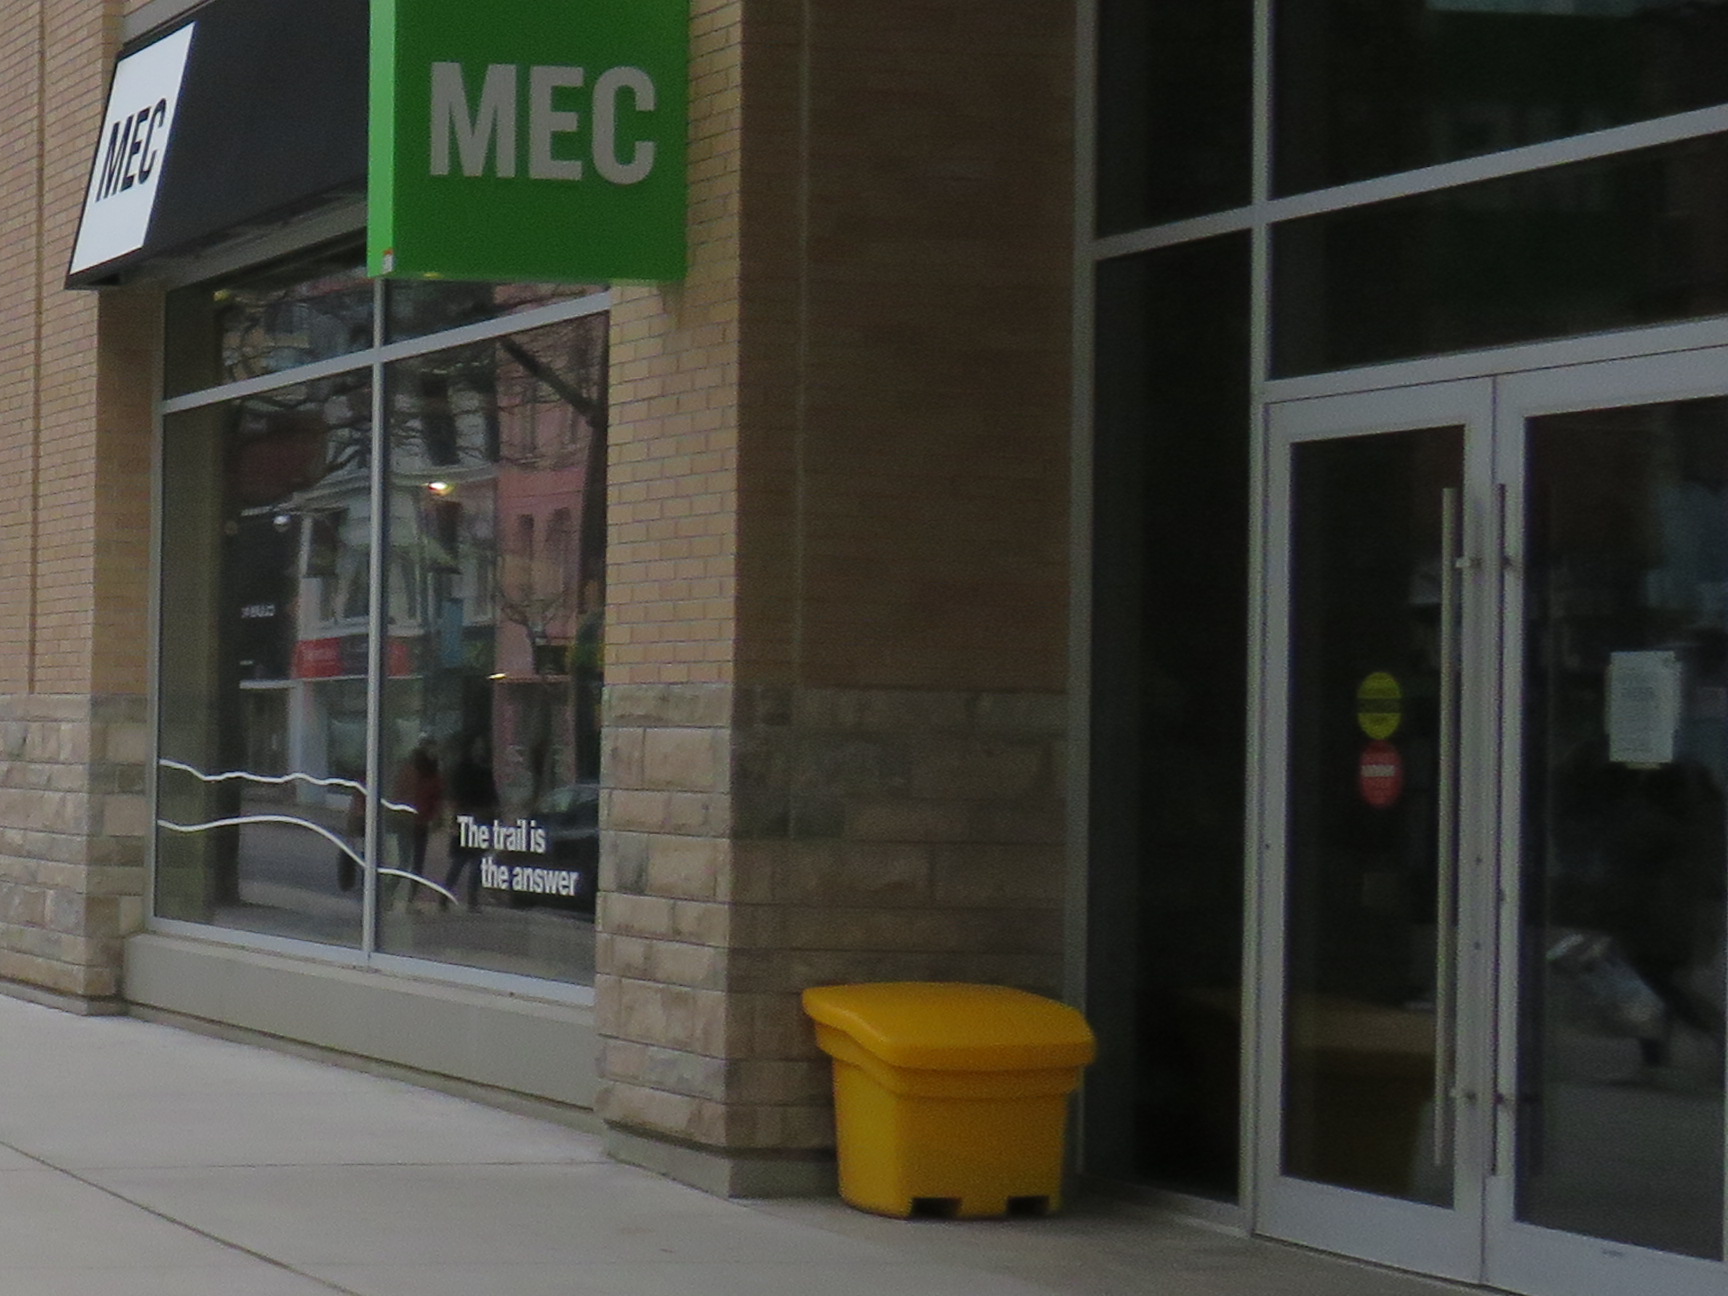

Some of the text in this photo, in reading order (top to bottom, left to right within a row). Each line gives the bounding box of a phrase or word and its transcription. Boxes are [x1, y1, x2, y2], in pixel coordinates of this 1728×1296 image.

[94, 97, 167, 203] MEC
[428, 61, 658, 185] MEC
[456, 815, 546, 853] The trail is
[480, 856, 580, 896] the answer
